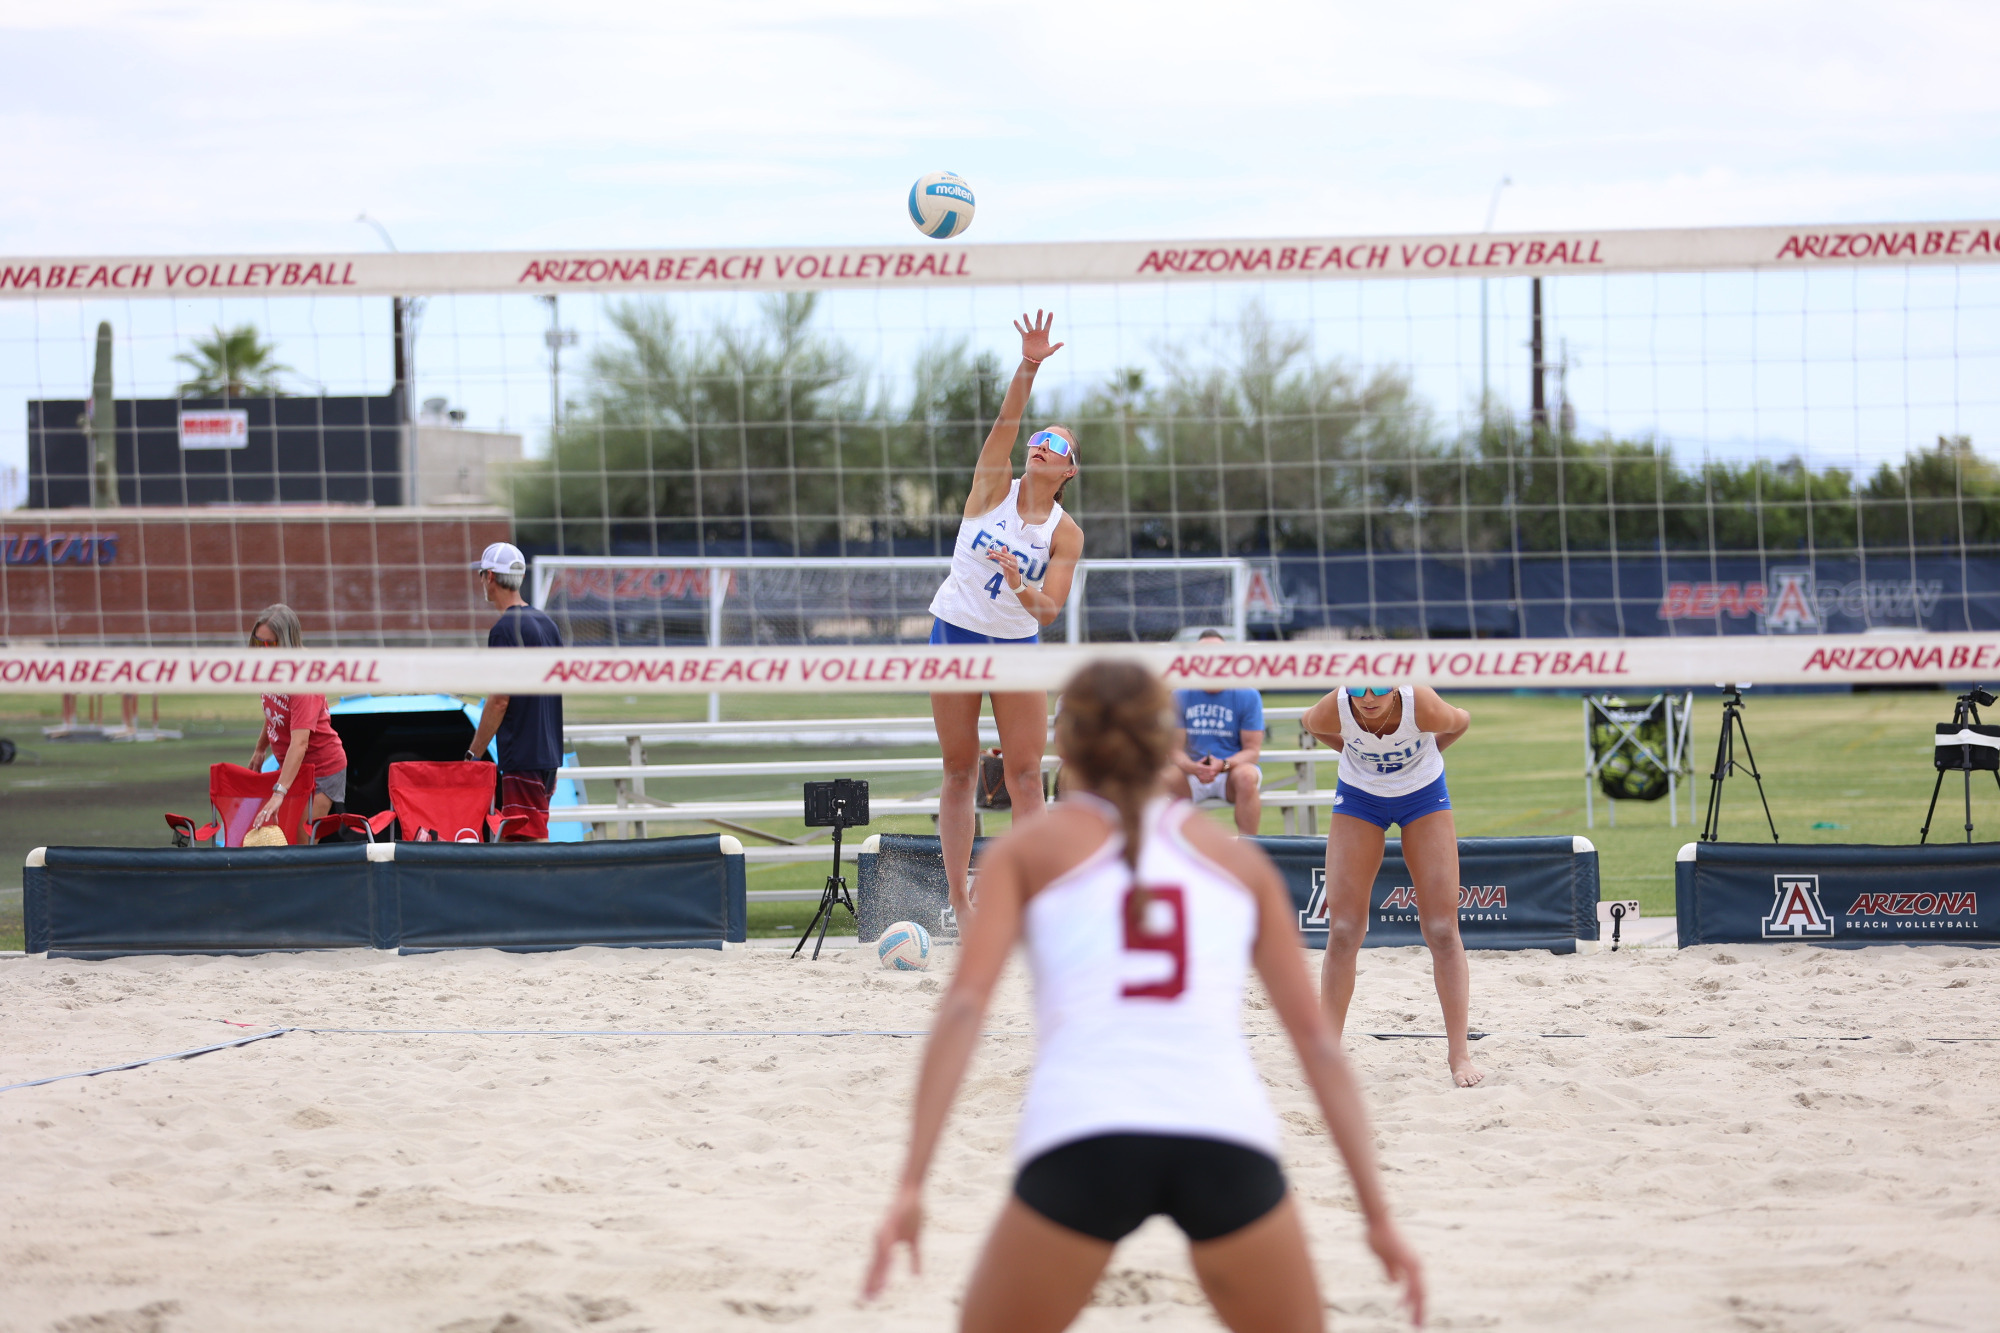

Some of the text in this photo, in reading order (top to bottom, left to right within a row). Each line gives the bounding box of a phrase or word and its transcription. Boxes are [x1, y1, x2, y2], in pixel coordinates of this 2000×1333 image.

[935, 185, 973, 202] molten
[1401, 239, 1605, 269] VOLLEYBALL
[1921, 228, 2000, 256] BEA
[165, 262, 357, 288] VOLLEYBALL
[775, 252, 970, 280] VOLLEYBALL
[984, 572, 1004, 600] 4
[801, 657, 996, 682] VOLLEYBALL
[1427, 651, 1630, 677] VOLLEYBALL
[1948, 644, 2000, 670] BE
[189, 659, 381, 684] VOLLEYBALL
[1185, 703, 1234, 723] NETJETS
[1380, 885, 1508, 910] ARNA
[1846, 891, 1978, 916] ARIZONA
[1380, 914, 1421, 922] BEACH
[1846, 921, 1979, 929] BEACH VOLLEYBALL
[1121, 885, 1186, 1000] 9
